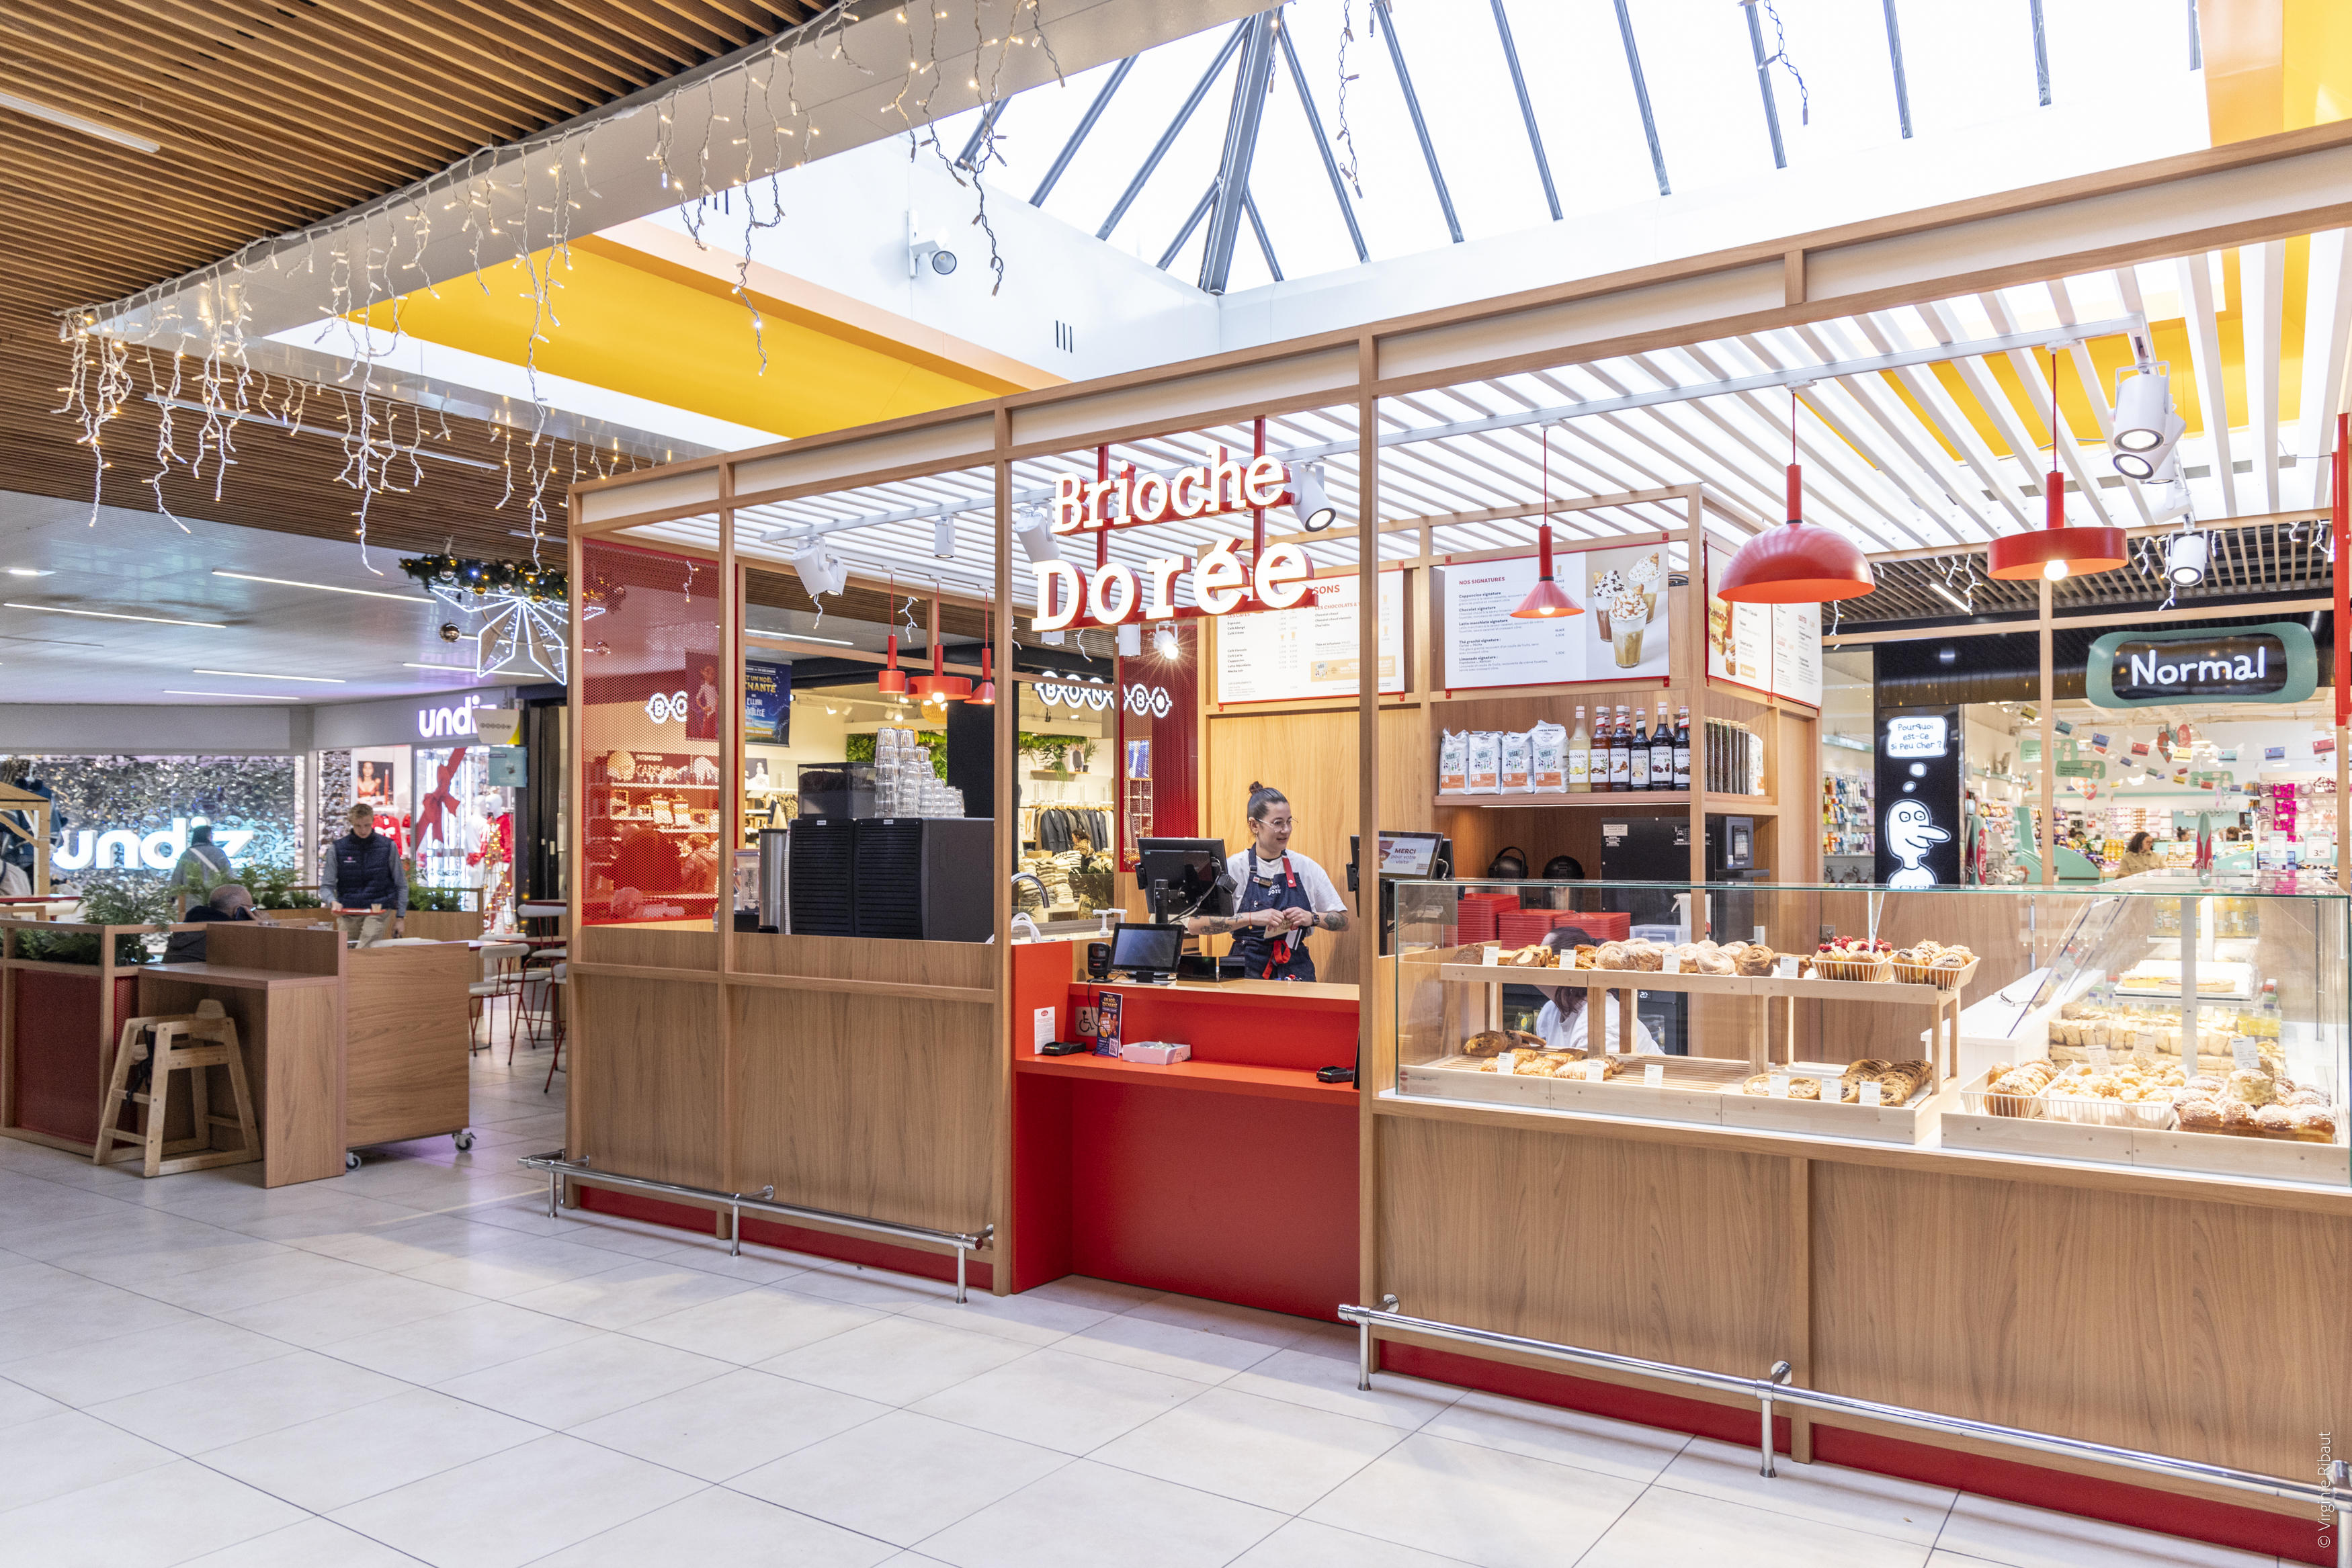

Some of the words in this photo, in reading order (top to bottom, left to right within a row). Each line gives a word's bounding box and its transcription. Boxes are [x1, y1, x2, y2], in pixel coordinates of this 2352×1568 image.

[1050, 444, 1288, 535] Brioche
[1032, 537, 1313, 632] Dorée
[1472, 576, 1505, 584] SIGNATURES
[2131, 646, 2267, 687] Normal
[418, 695, 497, 738] undi
[1898, 722, 1933, 731] Pourquoi
